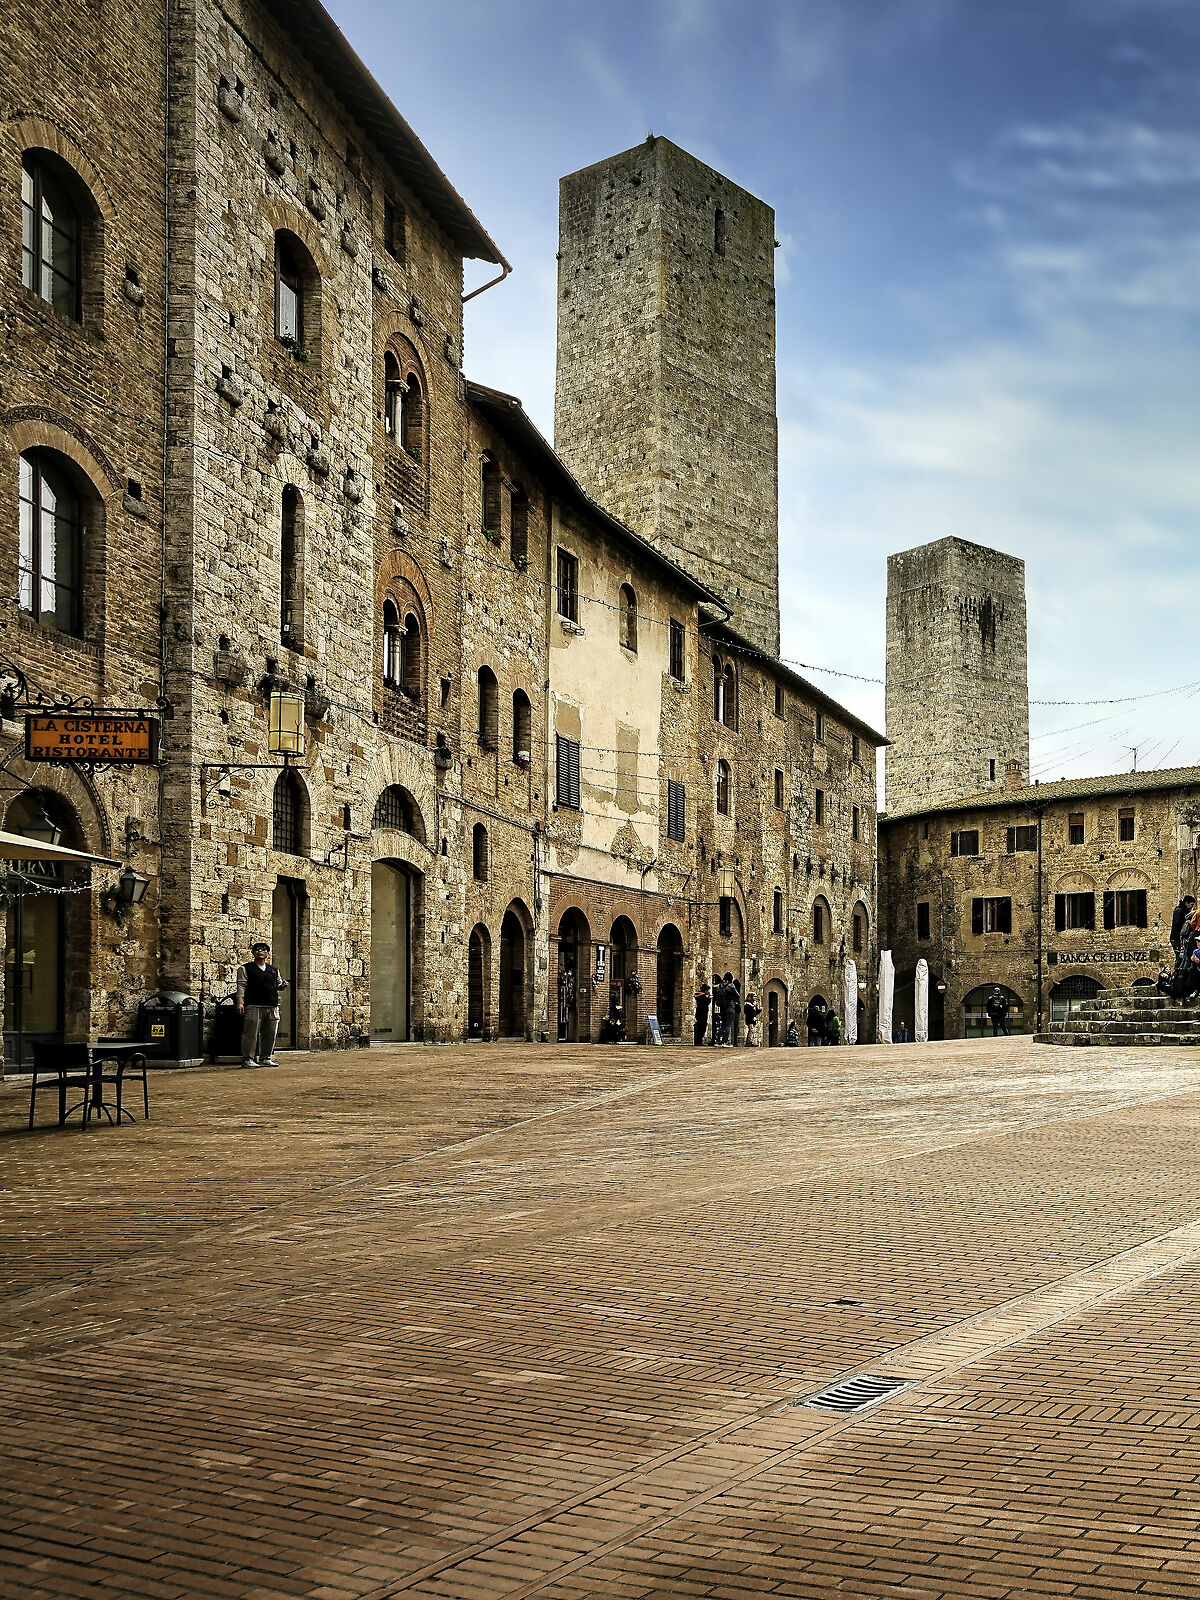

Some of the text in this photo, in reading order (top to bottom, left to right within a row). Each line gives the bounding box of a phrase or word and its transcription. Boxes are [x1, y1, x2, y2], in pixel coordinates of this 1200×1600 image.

[32, 719, 148, 734] LA CISTERNA
[59, 734, 123, 746] HOTEL
[32, 746, 148, 758] RISTORANTE
[1060, 951, 1148, 963] BANCA CR FIRENZE
